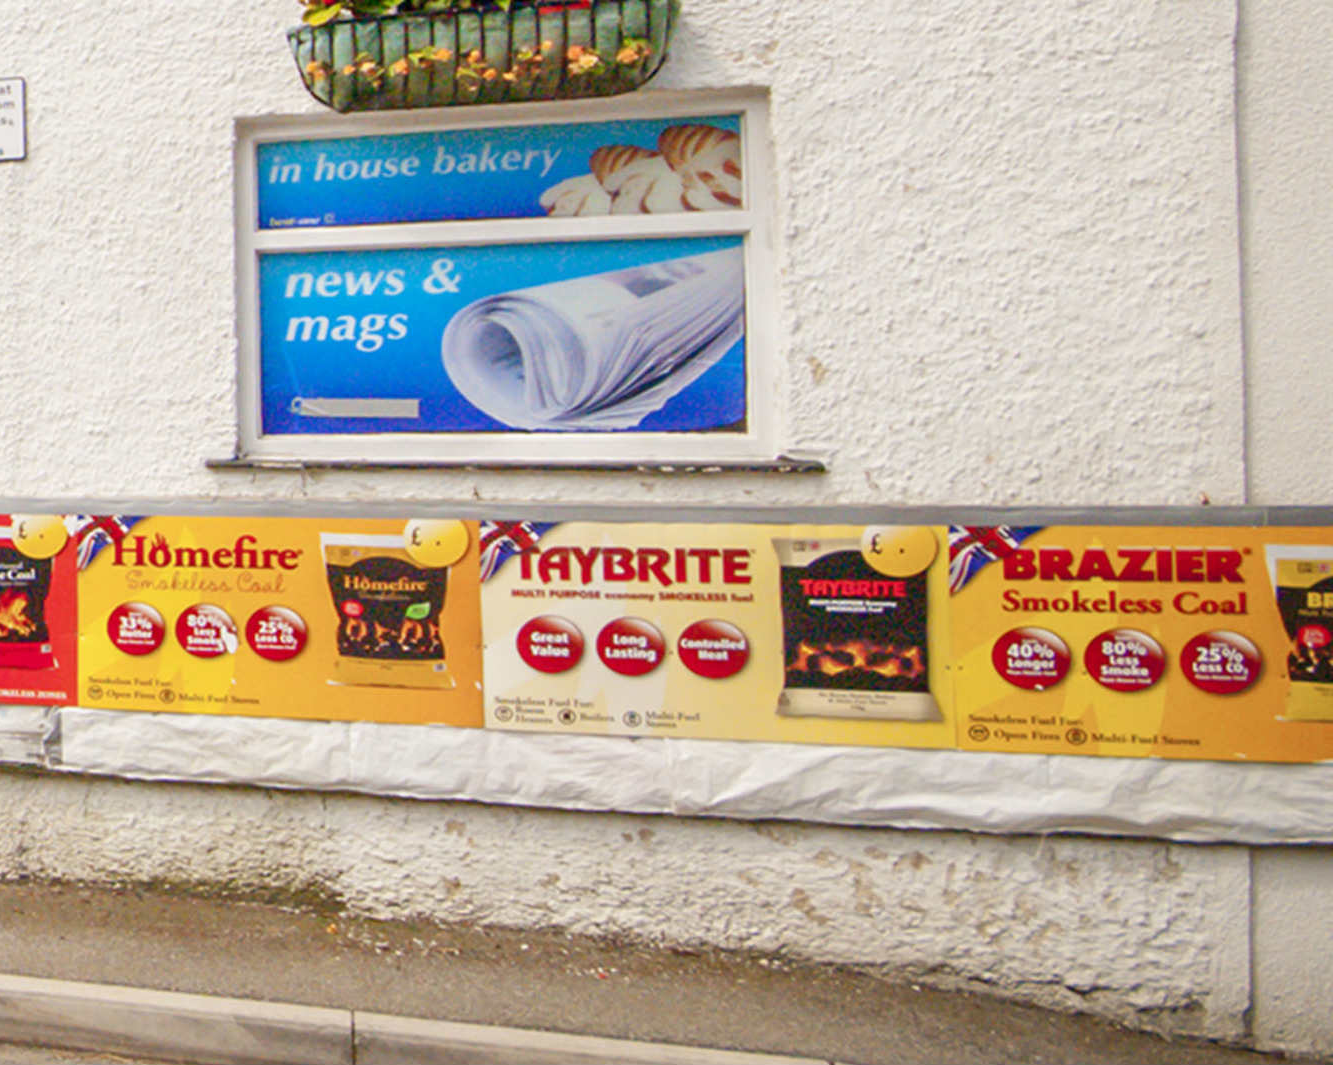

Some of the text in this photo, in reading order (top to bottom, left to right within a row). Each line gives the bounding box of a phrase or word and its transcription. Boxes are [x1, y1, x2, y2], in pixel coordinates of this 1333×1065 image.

[269, 144, 562, 184] in house bakery
[285, 259, 463, 298] news &
[285, 313, 409, 353] mags
[112, 533, 300, 570] Homefire
[520, 546, 753, 587] TAYBRITE
[1002, 547, 1245, 583] BRAZIER
[7, 568, 36, 580] Coal
[126, 570, 285, 593] Smokeless Coal
[343, 575, 428, 591] Homefire
[798, 579, 908, 597] TAYBRITE
[510, 589, 545, 598] MULTI
[549, 590, 601, 600] PURPOSE
[659, 592, 727, 603] SMOKELESS
[1002, 590, 1247, 615] Smokeless Coal
[258, 621, 293, 635] 25%
[531, 632, 569, 644] Great
[613, 634, 648, 649] Long
[680, 639, 746, 651] Controlled
[530, 645, 570, 658] Value
[605, 647, 657, 663] Lasting
[1007, 643, 1055, 658] 40%
[1101, 641, 1147, 656] 80%
[1196, 647, 1243, 664] 25%
[697, 651, 729, 662] Heat
[1109, 655, 1140, 666] Less
[1008, 658, 1055, 671] Longer
[1100, 665, 1149, 677] Smoke
[1192, 662, 1223, 673] Less
[968, 713, 1028, 725] Smokeless
[1031, 715, 1055, 726] Fuel
[994, 729, 1028, 742] Open
[1032, 730, 1061, 741] Fires
[1163, 735, 1201, 746] Stoves
